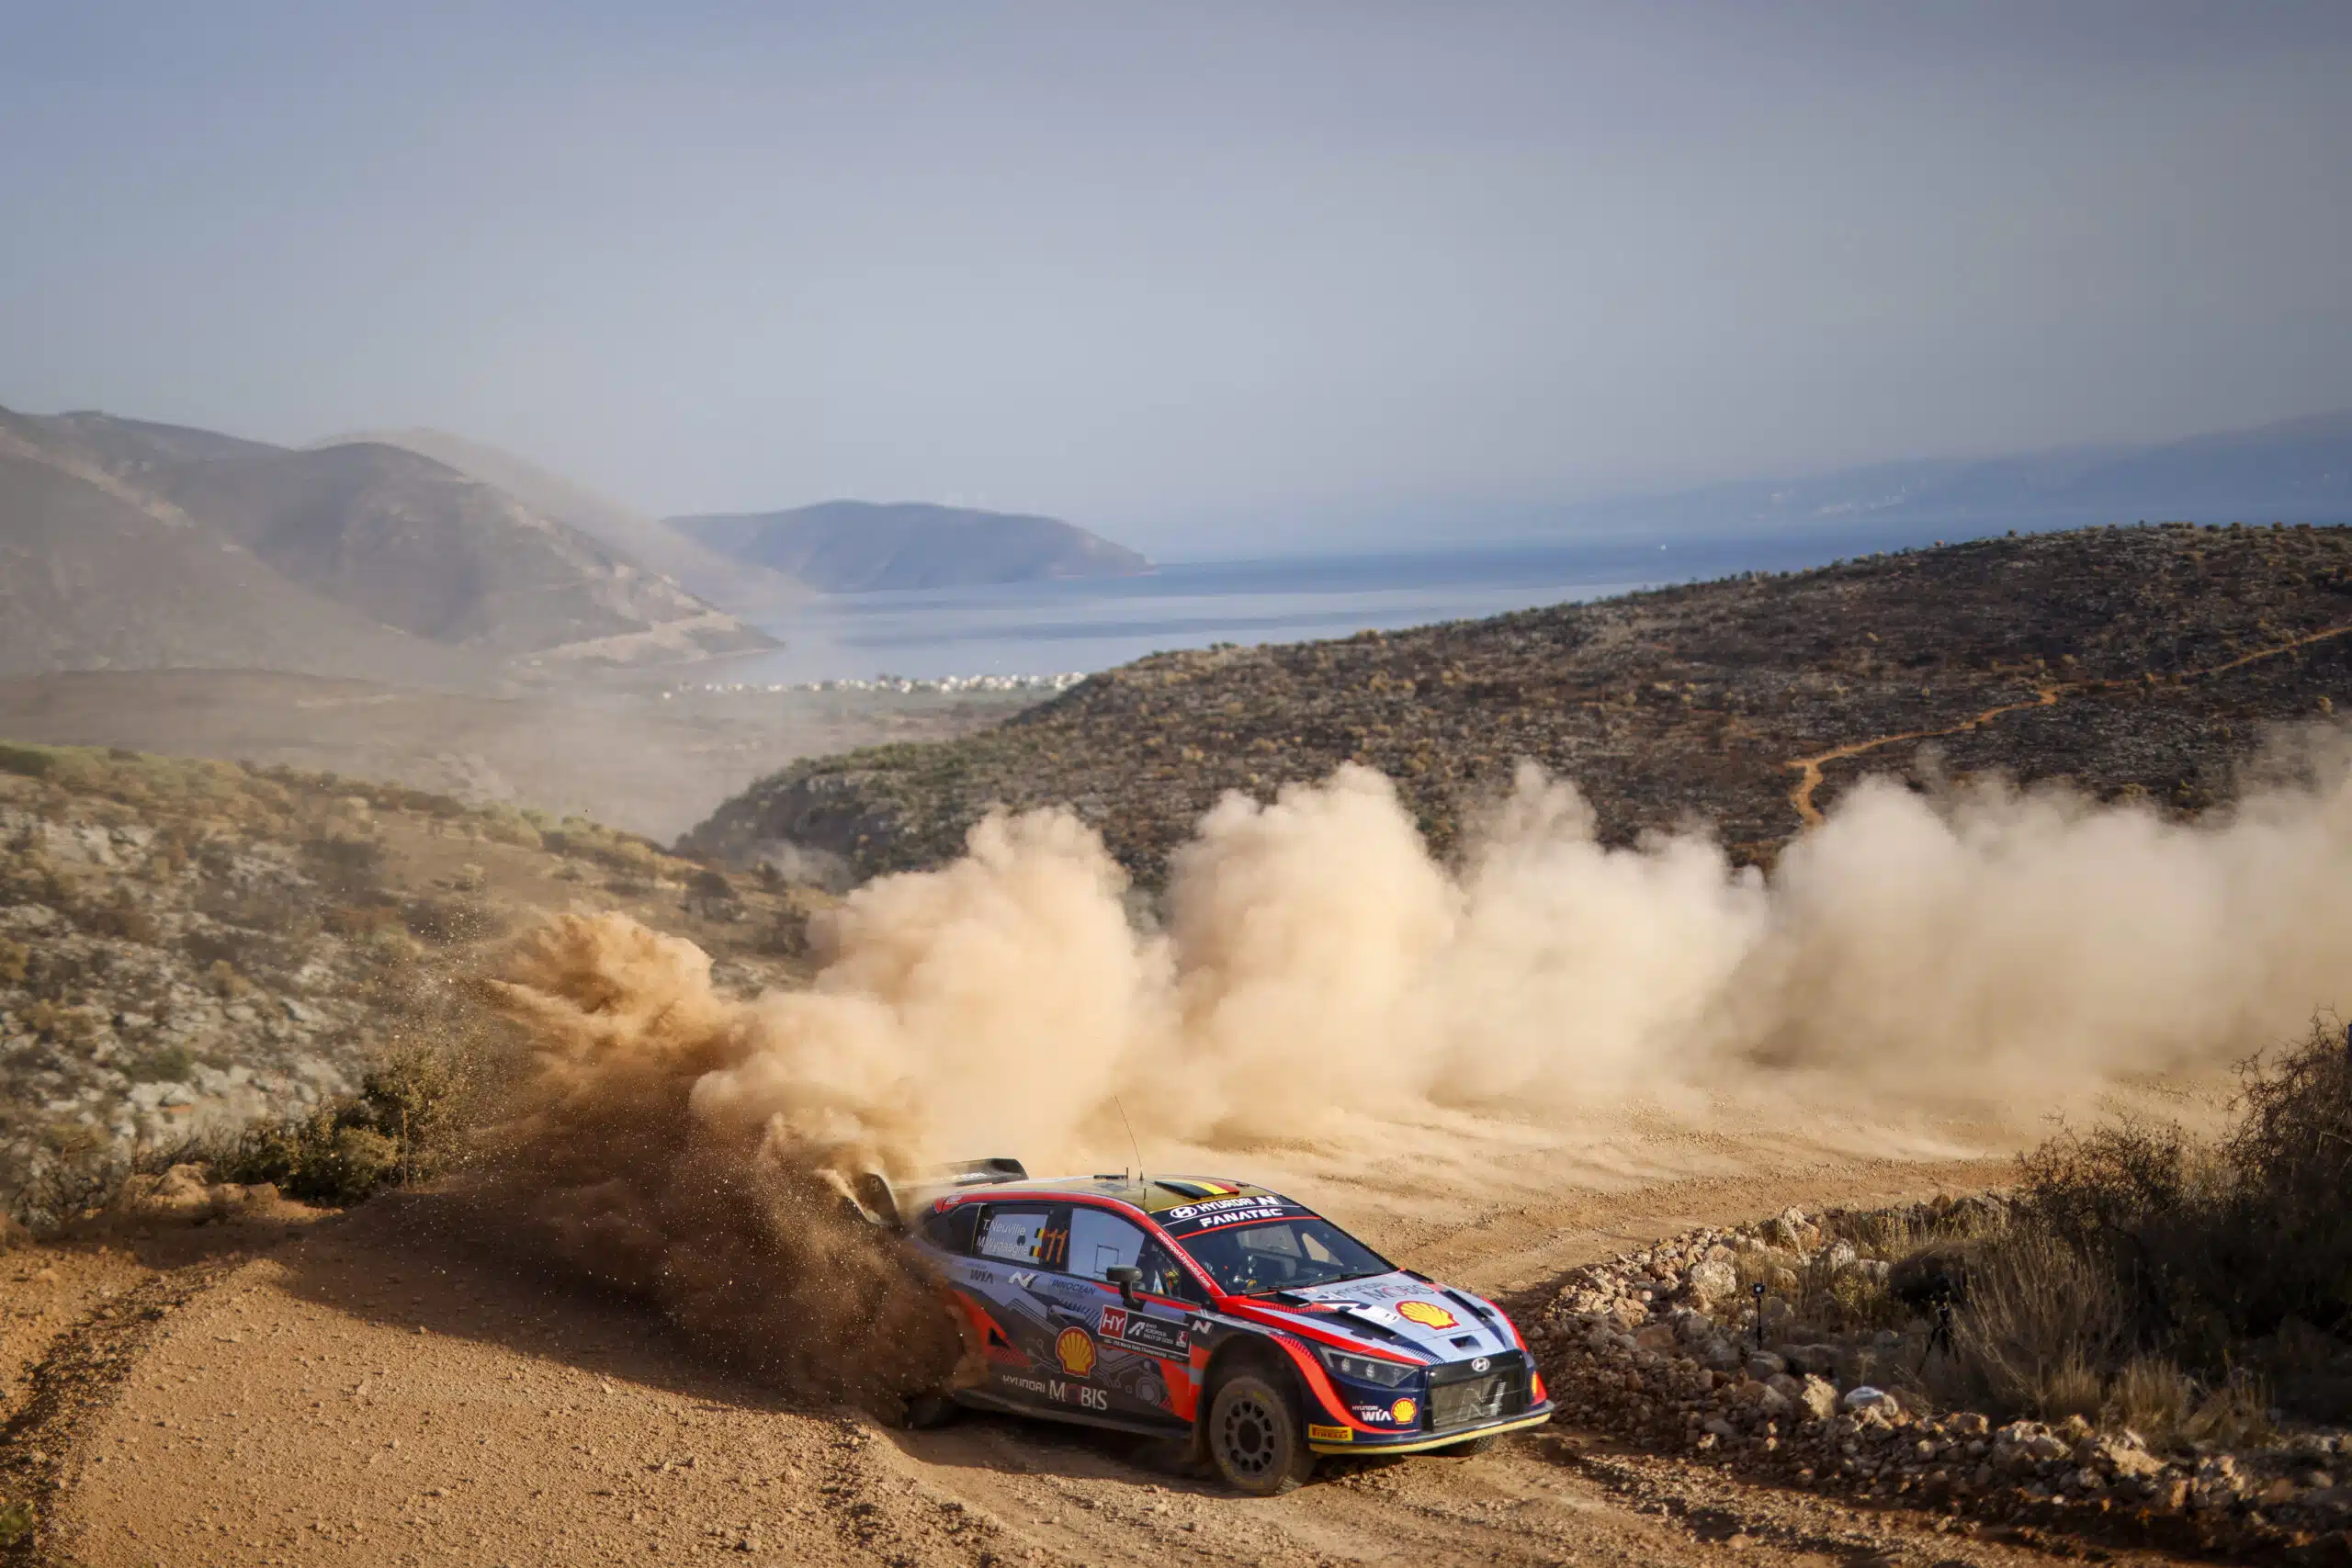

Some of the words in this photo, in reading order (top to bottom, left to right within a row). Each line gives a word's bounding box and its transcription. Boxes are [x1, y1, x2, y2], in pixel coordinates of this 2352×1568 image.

[1197, 1197, 1256, 1213] HYUNDAI
[1200, 1208, 1283, 1227] FANATEC
[1046, 1228, 1068, 1263] 11
[1102, 1313, 1125, 1331] HY
[1047, 1380, 1107, 1411] MOBIS
